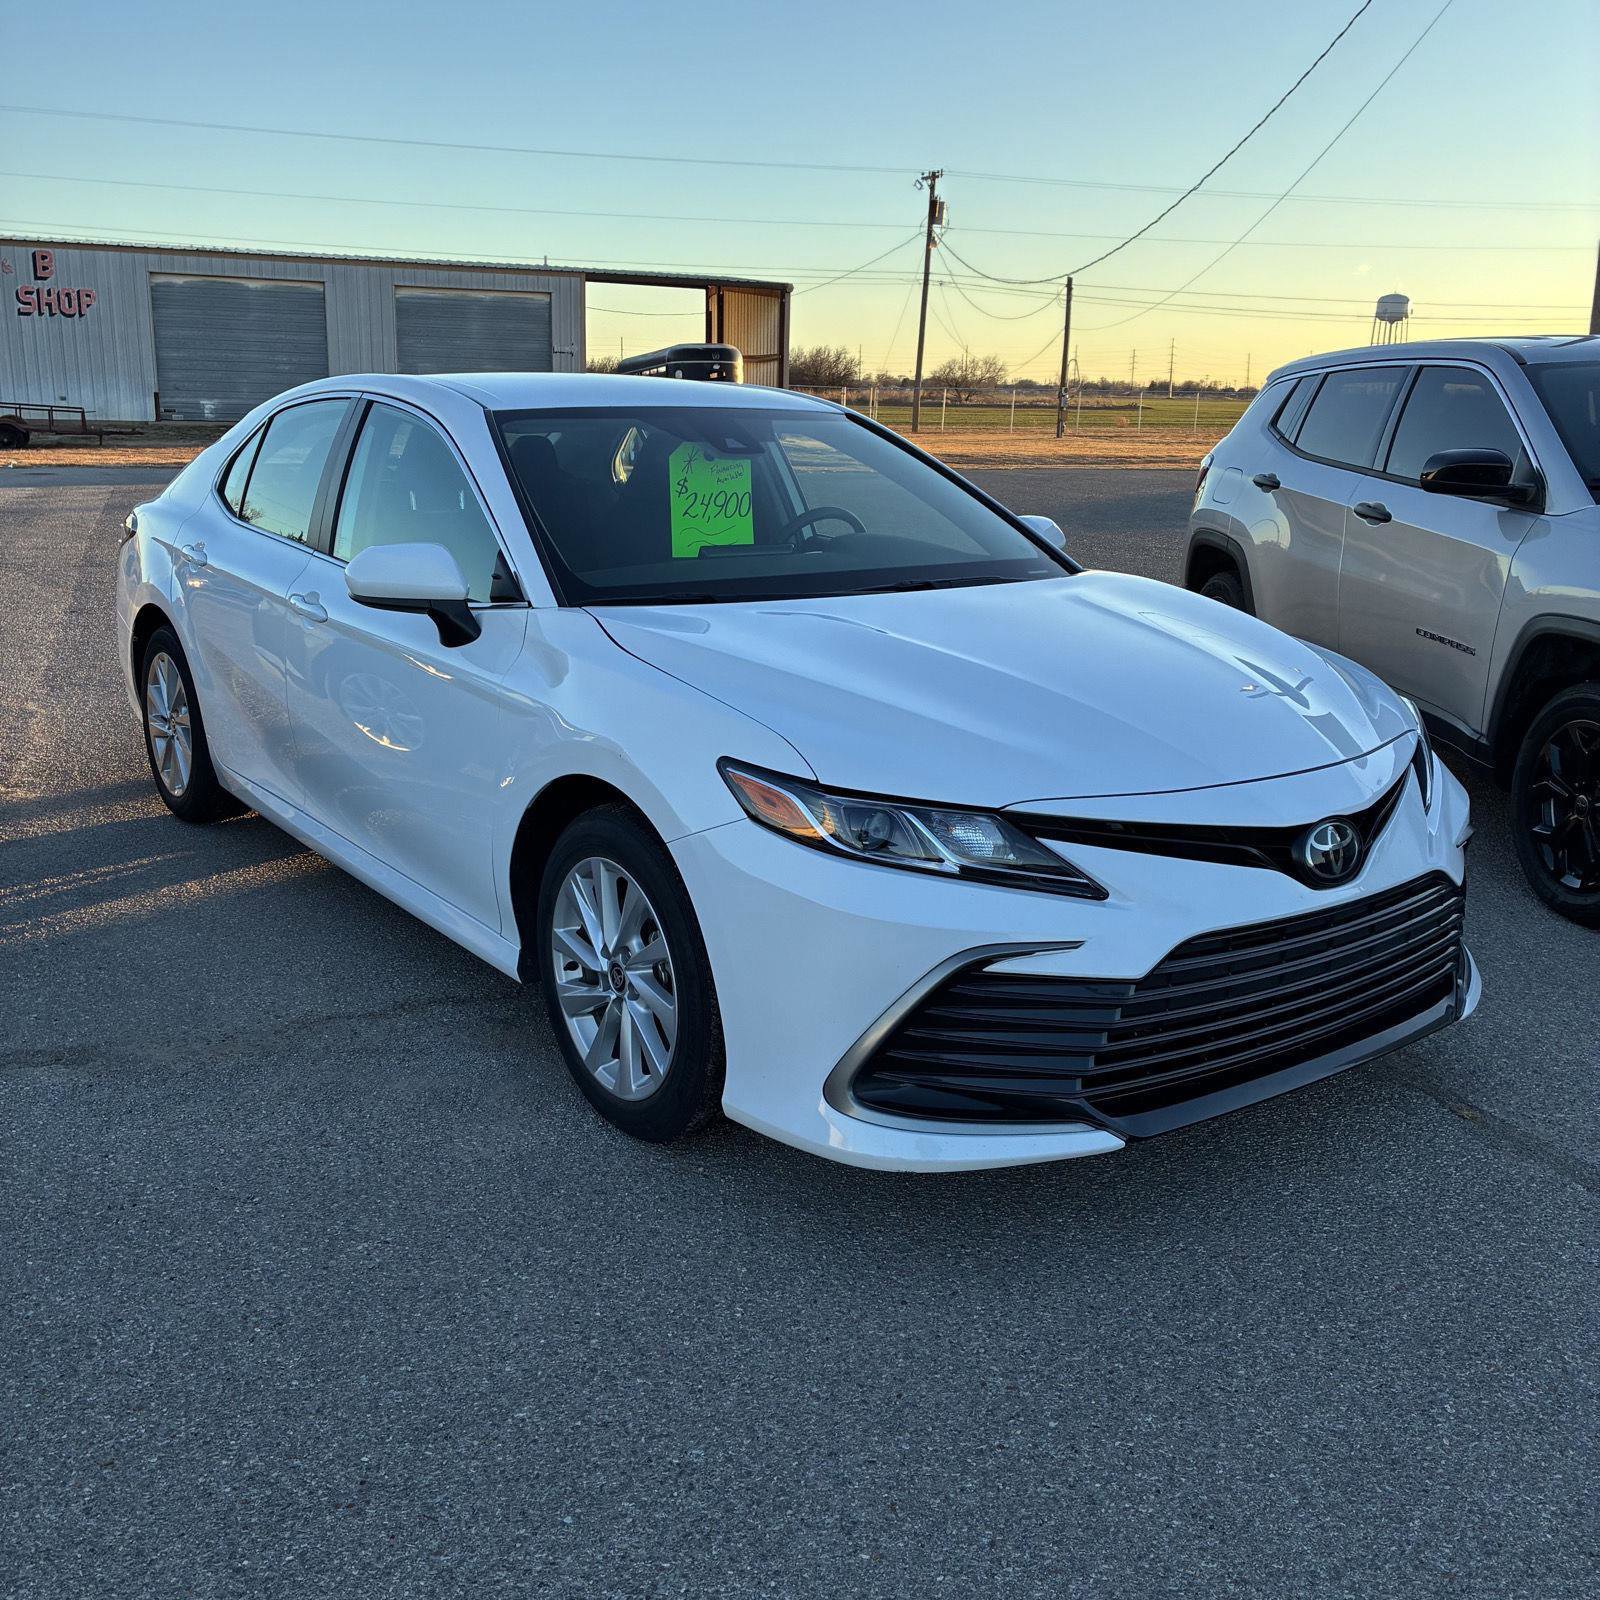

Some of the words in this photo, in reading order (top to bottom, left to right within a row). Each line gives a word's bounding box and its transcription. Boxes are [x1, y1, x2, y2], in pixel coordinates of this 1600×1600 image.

[32, 249, 54, 280] B
[15, 284, 96, 318] SHOP
[1415, 627, 1476, 657] COMPASS
